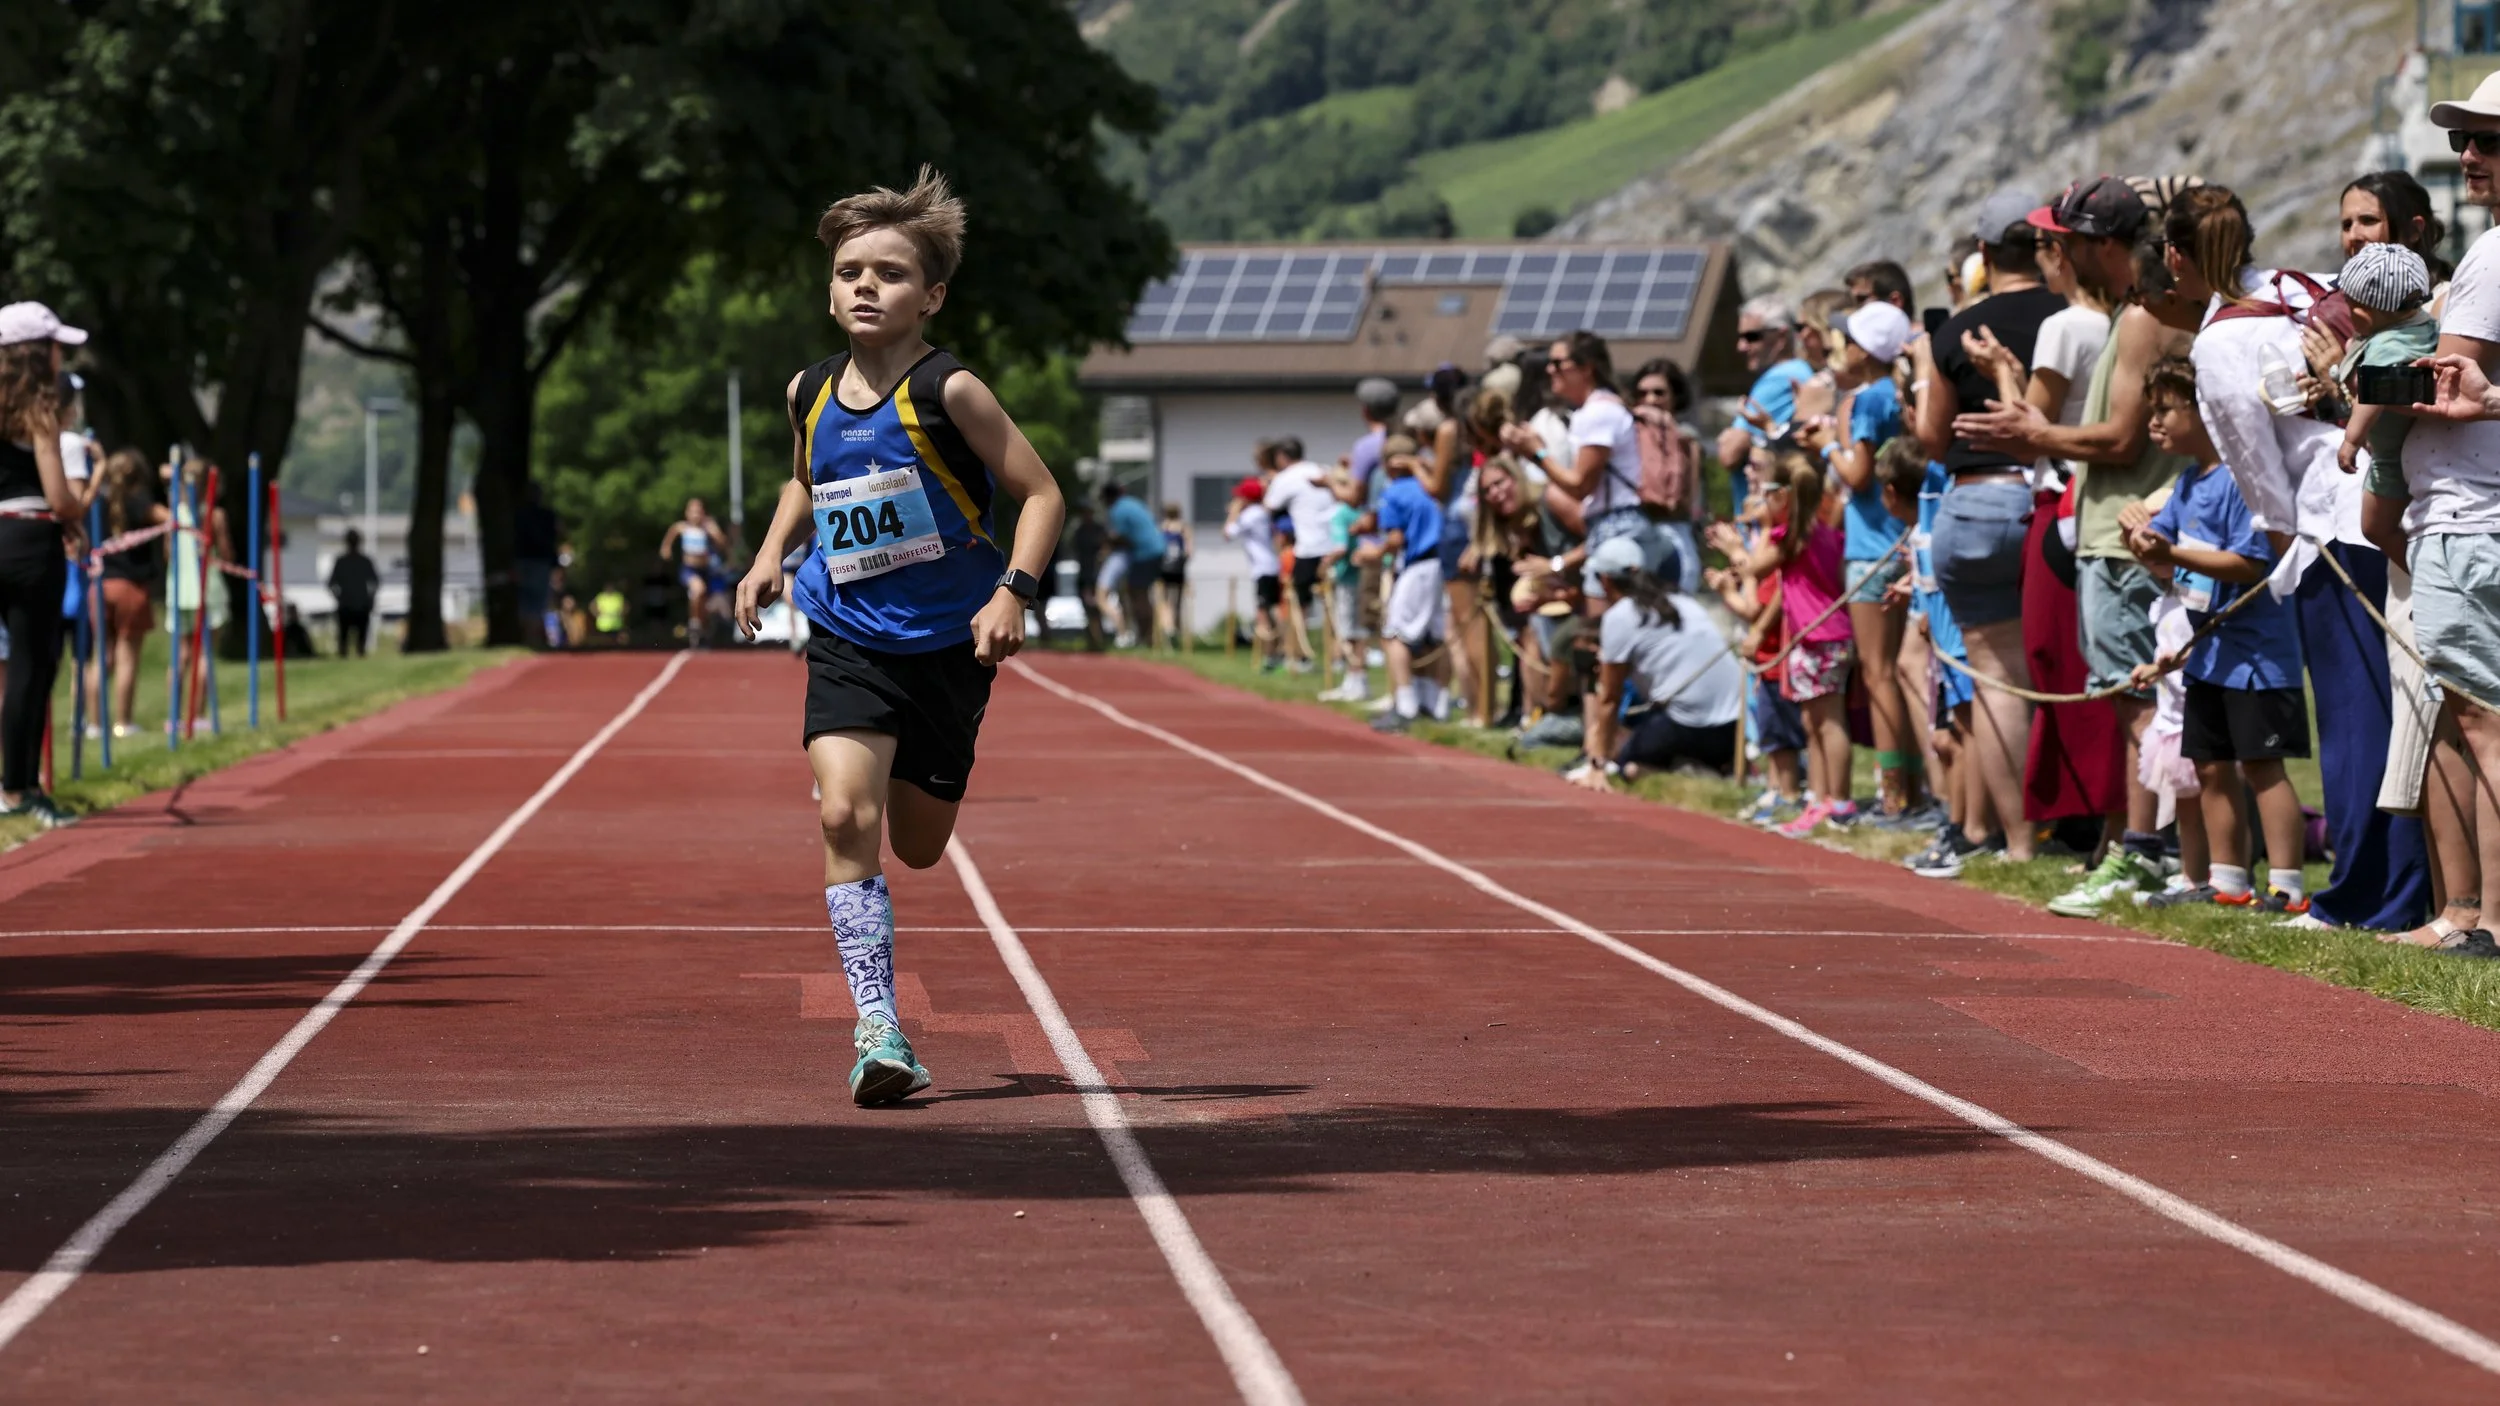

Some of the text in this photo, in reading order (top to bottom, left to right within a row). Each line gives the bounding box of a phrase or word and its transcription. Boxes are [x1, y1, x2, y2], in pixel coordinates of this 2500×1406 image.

[841, 427, 875, 438] panzeri
[867, 475, 908, 493] lonzalauf
[826, 487, 853, 502] gampel
[827, 501, 905, 551] 204
[892, 543, 939, 562] RAIFFEISEN
